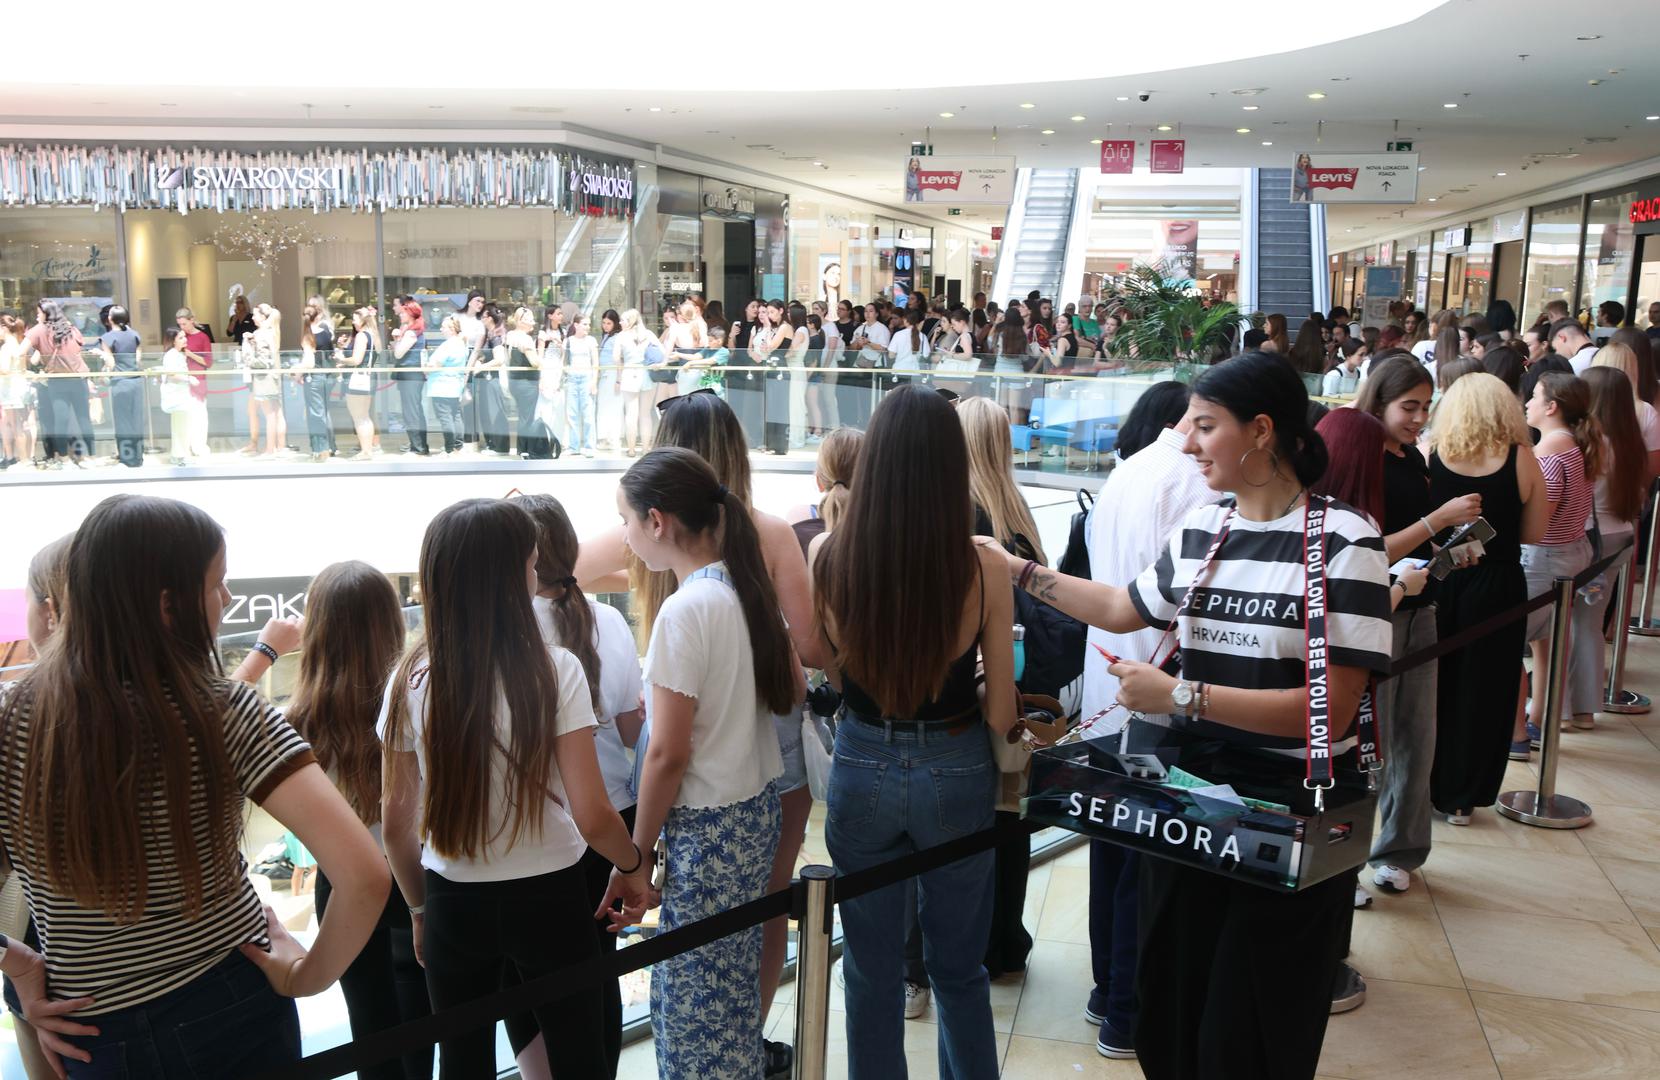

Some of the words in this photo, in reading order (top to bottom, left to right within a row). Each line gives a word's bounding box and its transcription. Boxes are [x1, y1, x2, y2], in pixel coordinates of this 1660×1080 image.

[193, 166, 338, 190] SWAROVSKI
[583, 173, 632, 199] SWAROVSKI
[1306, 510, 1324, 538] SEE
[1307, 540, 1322, 573] YOU
[221, 592, 309, 624] ZAK
[1307, 577, 1324, 619] LOVE
[1191, 626, 1261, 648] HRVATSKA
[1308, 637, 1326, 670] SEE
[1309, 674, 1328, 709] YOU
[1359, 691, 1373, 725] OVE
[1309, 715, 1329, 759] LOVE
[1360, 742, 1377, 764] SE
[1067, 791, 1241, 863] SEPHORA
